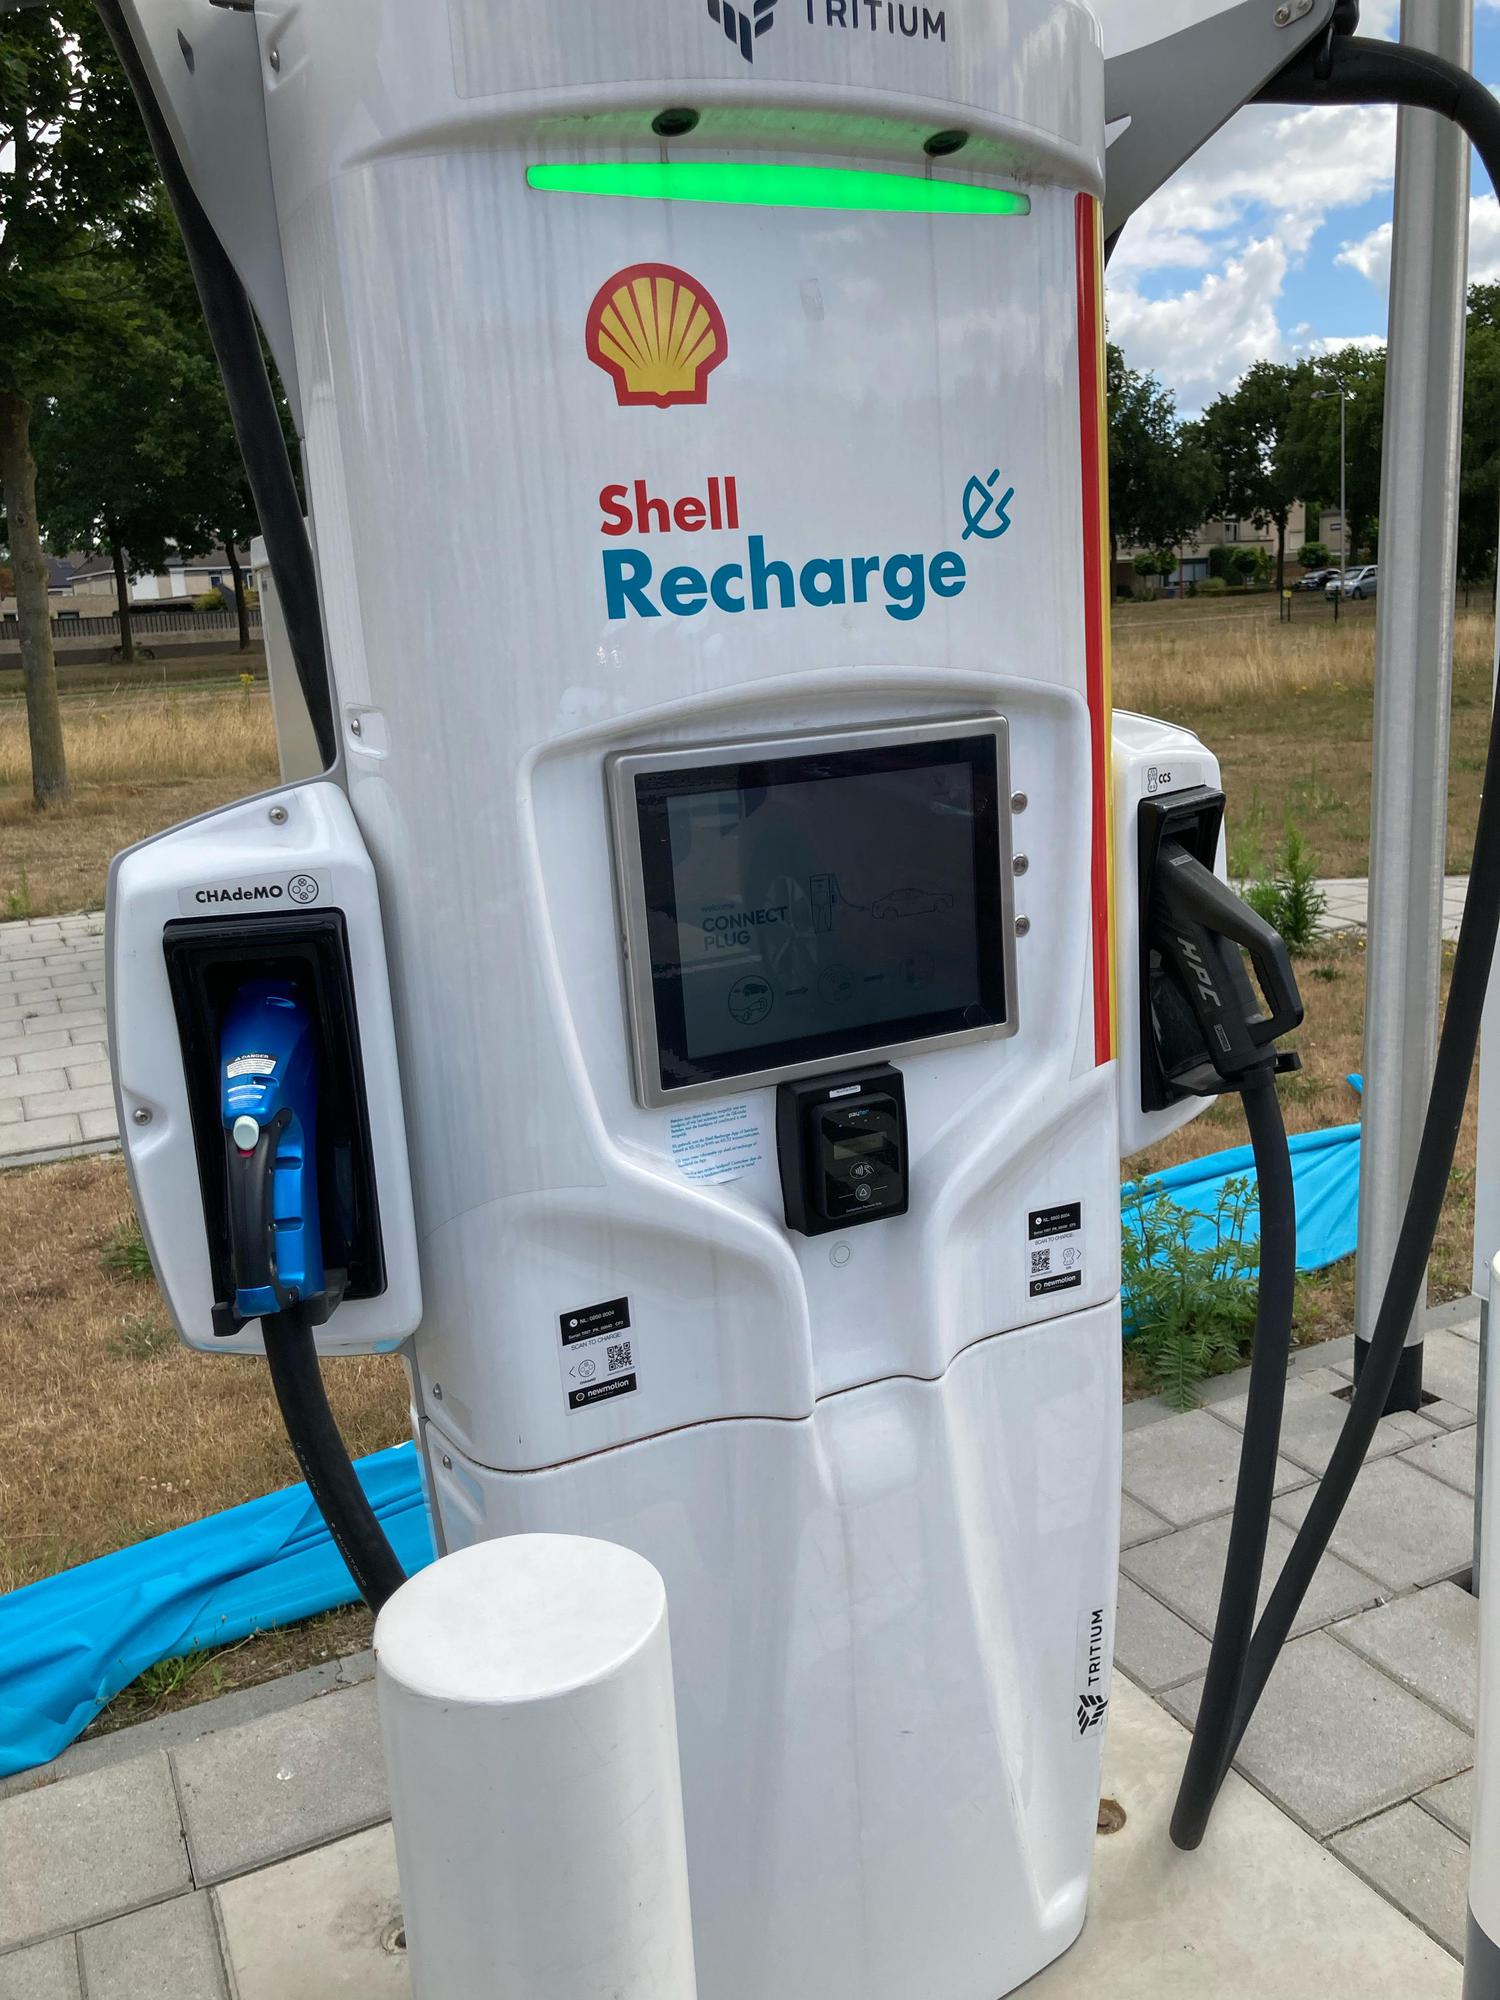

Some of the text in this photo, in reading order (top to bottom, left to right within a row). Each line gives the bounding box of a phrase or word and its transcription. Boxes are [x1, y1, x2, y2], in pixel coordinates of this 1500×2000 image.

[806, 0, 946, 42] TRITIUM
[599, 476, 739, 536] Shell
[602, 535, 967, 621] Recharge
[1159, 772, 1171, 784] CCS
[195, 885, 283, 904] CHAdeMO
[703, 906, 788, 932] CONNECT
[704, 930, 751, 951] PLUG
[1043, 1275, 1076, 1288] newmotion
[587, 1378, 629, 1397] newmotion
[1088, 1609, 1103, 1687] TRITIUM
